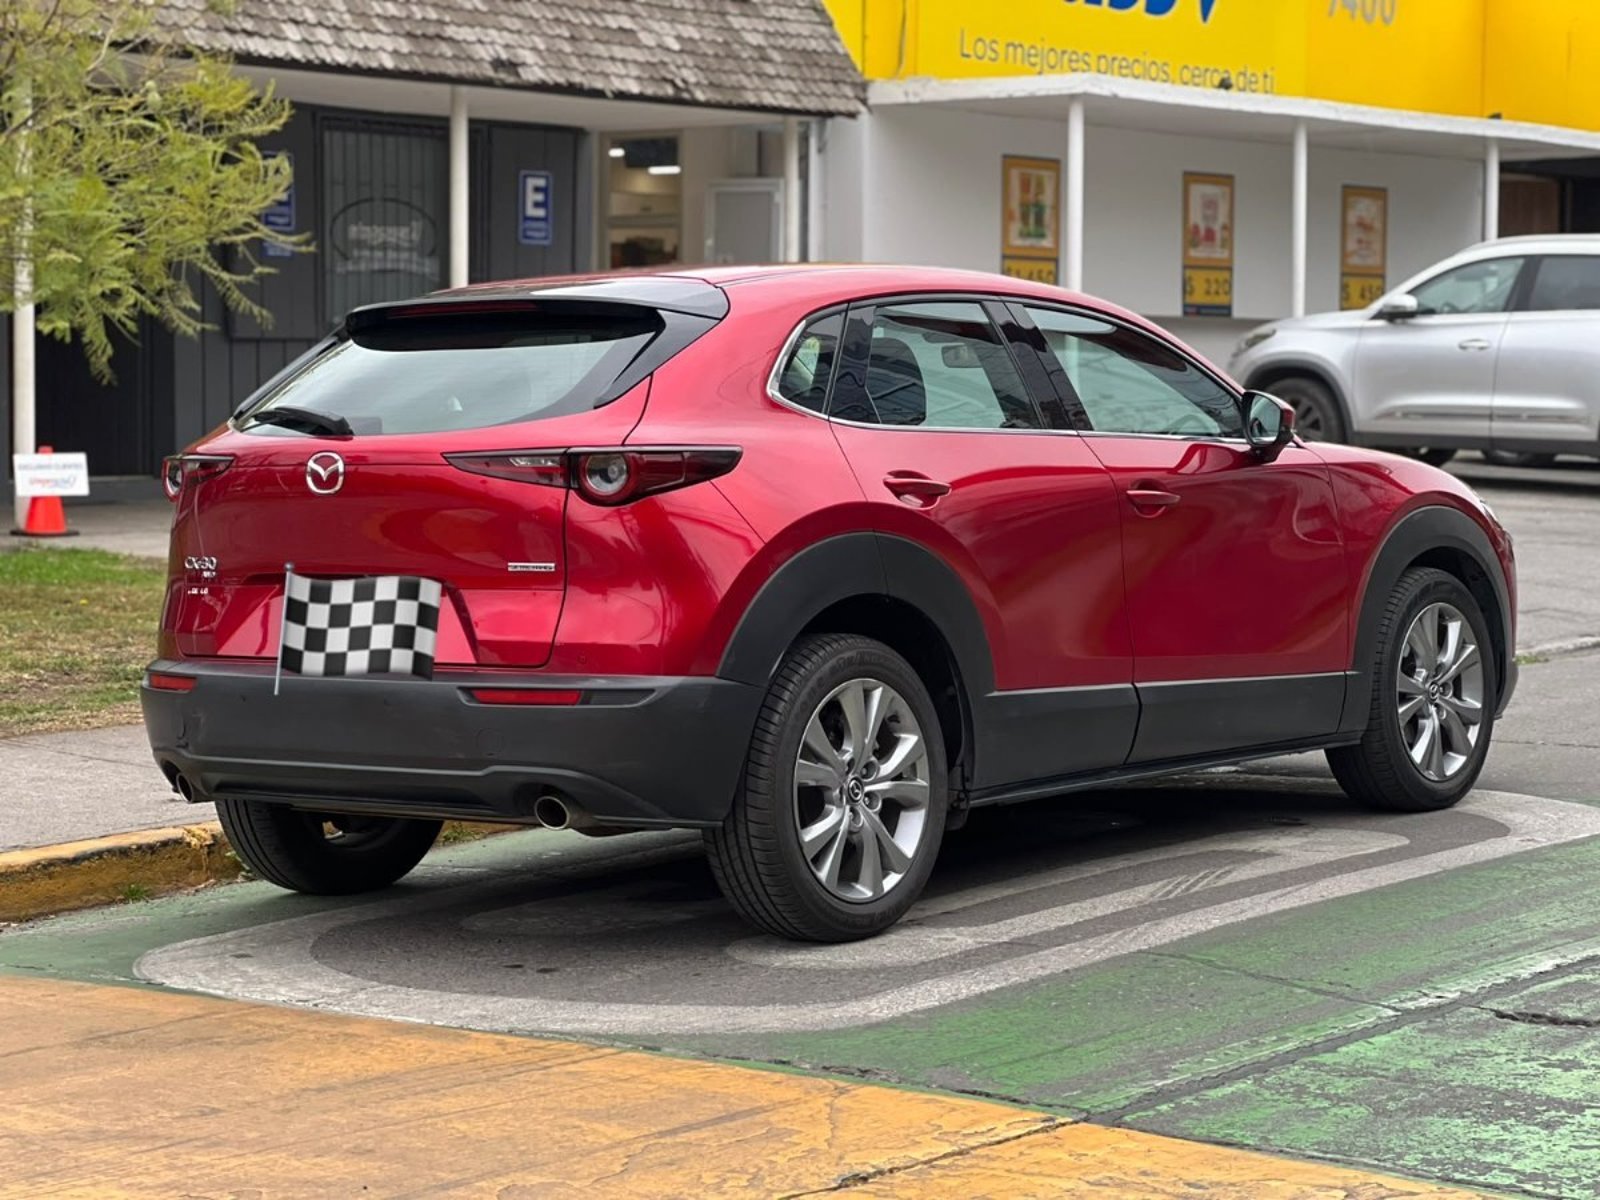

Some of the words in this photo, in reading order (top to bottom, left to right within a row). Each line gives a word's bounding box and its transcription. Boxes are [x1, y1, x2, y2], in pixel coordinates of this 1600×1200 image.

[959, 27, 999, 62] Los
[1005, 37, 1091, 75] mejores
[1236, 66, 1259, 93] de
[1263, 67, 1275, 94] ti
[525, 177, 547, 218] E
[184, 555, 217, 570] CX-30
